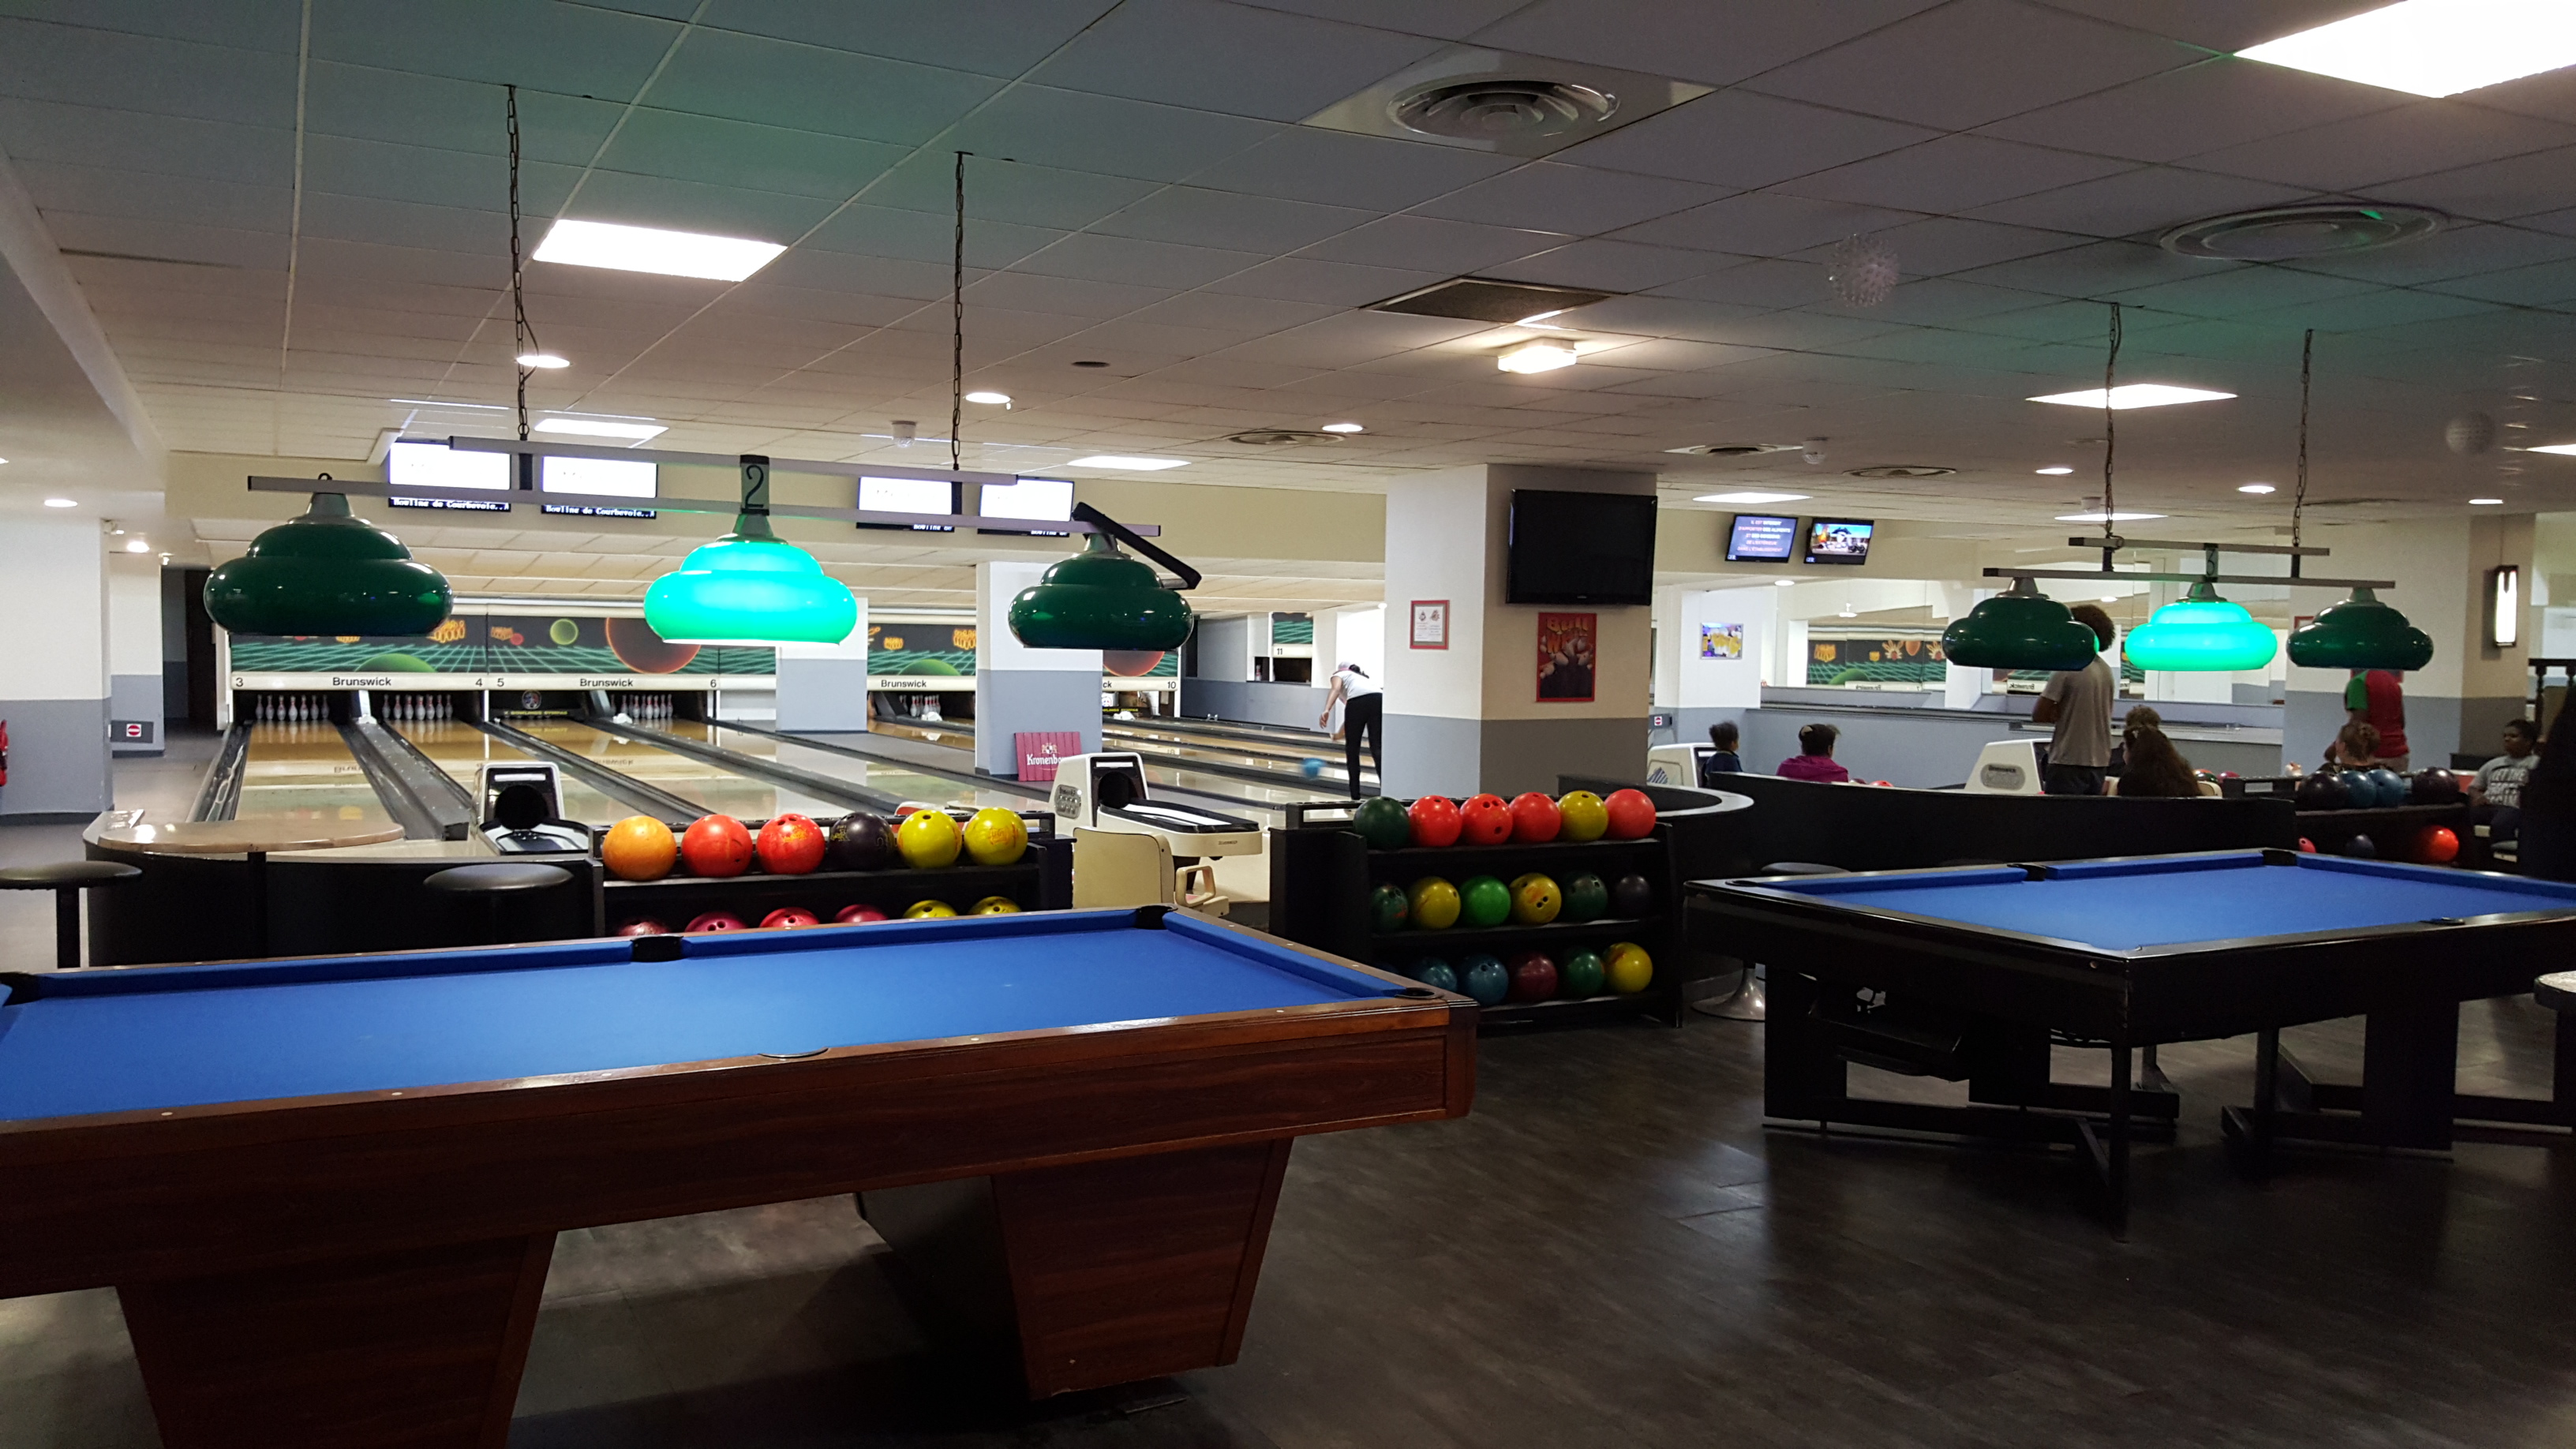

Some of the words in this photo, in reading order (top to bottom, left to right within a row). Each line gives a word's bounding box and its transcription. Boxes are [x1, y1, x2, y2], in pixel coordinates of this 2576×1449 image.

[745, 464, 764, 509] 2
[1547, 616, 1589, 632] Bull
[1276, 647, 1283, 656] 11
[235, 677, 244, 687] 3
[332, 677, 391, 686] Brunswick
[475, 677, 483, 687] 4
[497, 677, 505, 687] 5
[580, 678, 634, 687] Brunswick
[710, 678, 717, 688] 6
[881, 680, 927, 688] Brunswick
